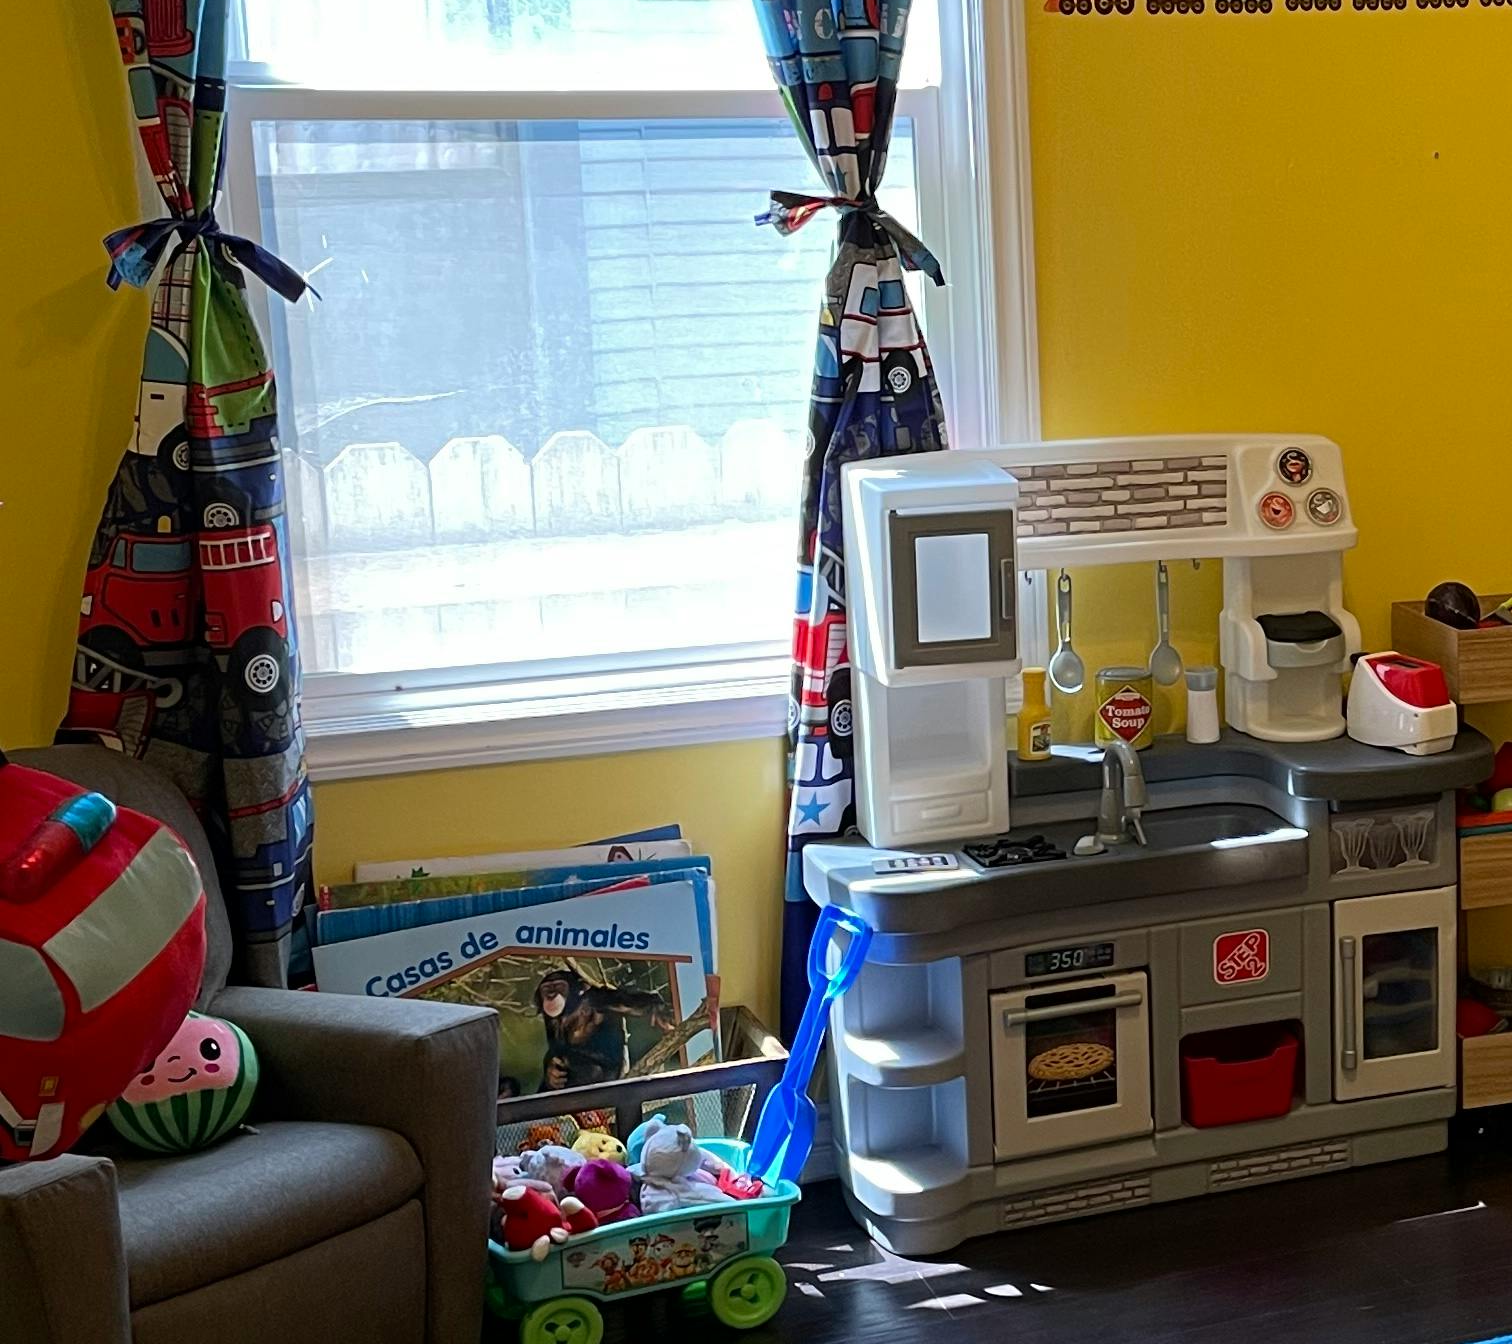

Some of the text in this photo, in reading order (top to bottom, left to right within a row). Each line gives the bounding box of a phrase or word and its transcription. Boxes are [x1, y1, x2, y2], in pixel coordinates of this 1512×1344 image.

[1106, 705, 1150, 716] Tomato
[1112, 717, 1145, 729] Soup
[366, 920, 650, 998] Casas de animales
[1050, 949, 1084, 970] 350
[1218, 933, 1260, 980] STEP
[1245, 957, 1265, 976] 2
